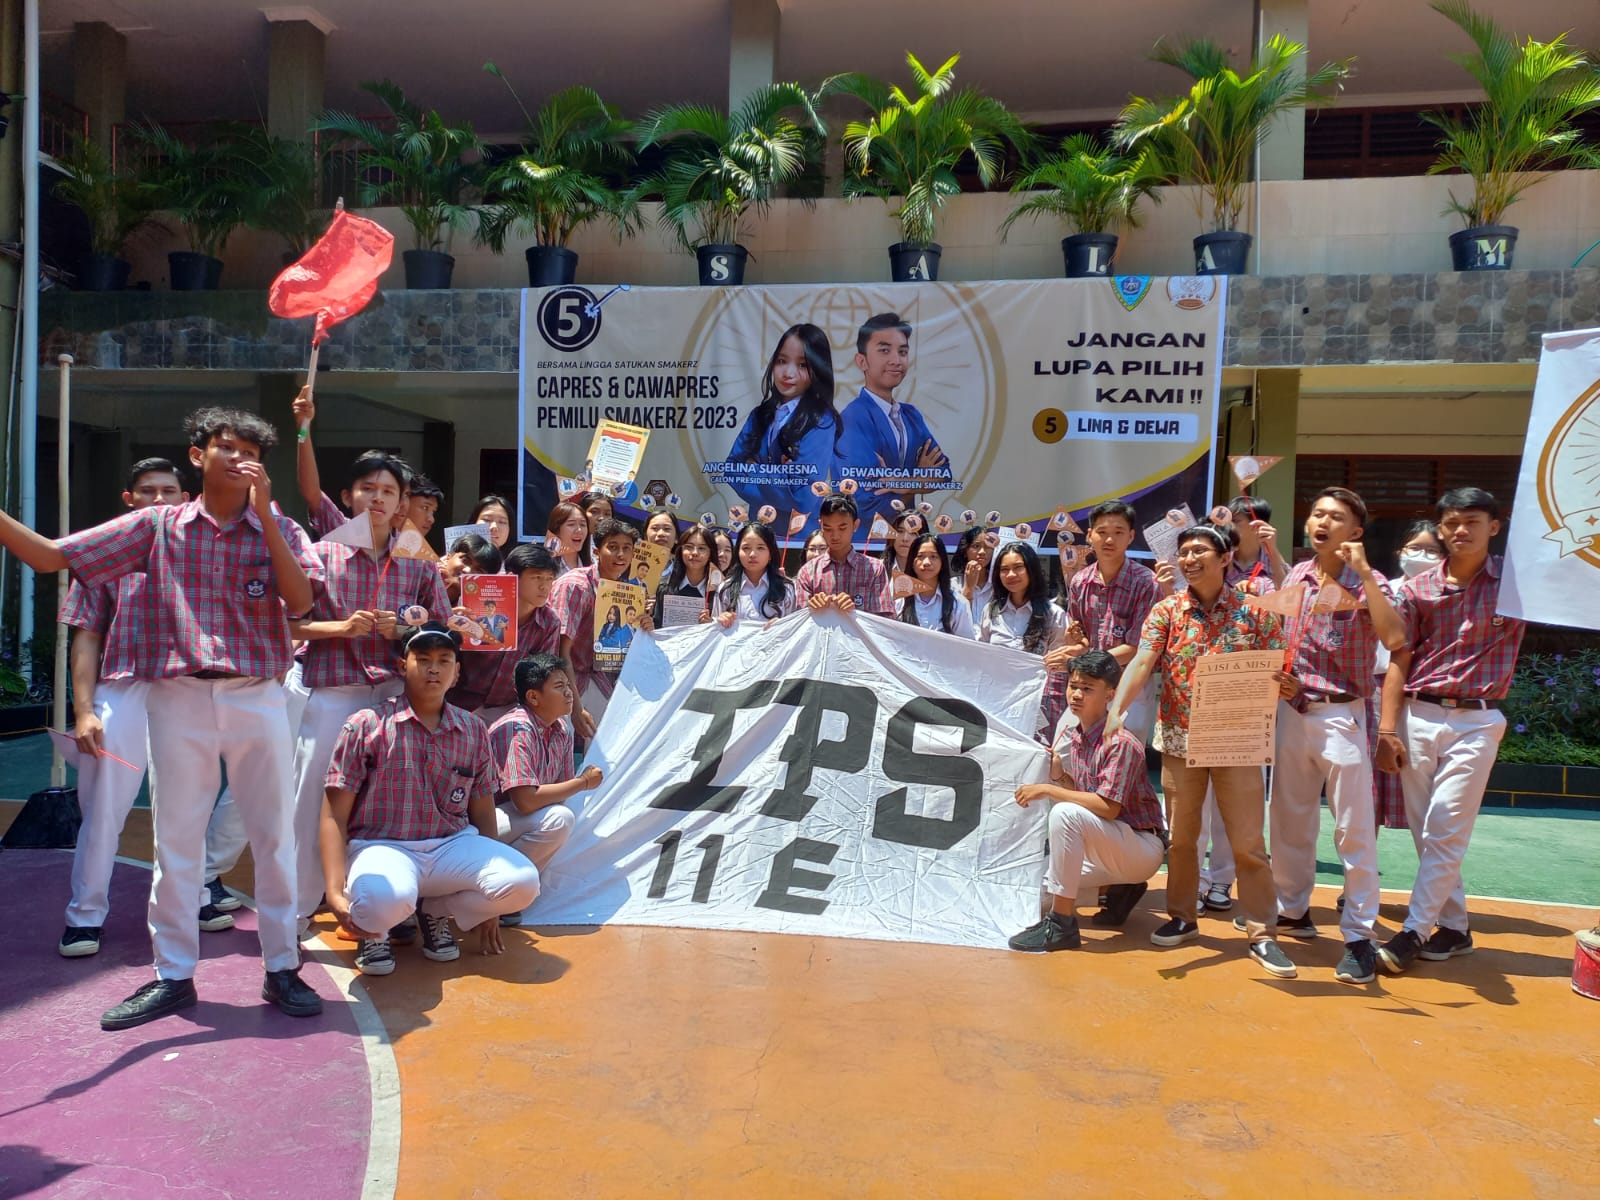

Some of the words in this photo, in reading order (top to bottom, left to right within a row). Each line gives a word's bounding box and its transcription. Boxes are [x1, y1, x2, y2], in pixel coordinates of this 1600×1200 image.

[1475, 239, 1506, 266] M
[710, 255, 729, 281] S
[908, 254, 930, 280] A
[557, 298, 582, 338] 5
[1067, 332, 1206, 348] JANGAN
[537, 361, 578, 369] BERSAMA
[580, 361, 612, 369] LINGGA
[614, 361, 656, 369] SATUKAN
[657, 360, 698, 369] SMAKERZ
[1033, 359, 1115, 375] LUPA
[1121, 360, 1204, 376] PILIH
[537, 376, 603, 399] CAPRES
[608, 377, 620, 399] &
[624, 375, 719, 399] CAWAPRES
[537, 406, 599, 429] PEMILU
[604, 406, 687, 429] SMAKERZ
[693, 406, 737, 429] 2023
[1044, 417, 1057, 434] 5
[1077, 418, 1113, 433] LINA
[1118, 420, 1129, 434] &
[1134, 420, 1180, 435] DEWA
[703, 462, 756, 474] ANGELINA
[759, 463, 818, 475] SUKRESNA
[841, 467, 910, 478] DEWANGGA
[913, 468, 951, 478] PUTRA
[710, 476, 735, 484] CALON
[736, 477, 772, 485] PRESIDEN
[774, 478, 809, 486] SMAKERZ
[858, 481, 884, 489] WAKIL
[885, 481, 922, 489] PRESIDEN
[924, 482, 963, 490] SMAKERZ
[1207, 663, 1229, 672] VISI
[1233, 661, 1241, 670] &
[1245, 660, 1271, 669] MISI
[647, 678, 988, 850] IPS
[647, 830, 724, 903] 11
[754, 837, 840, 915] E
